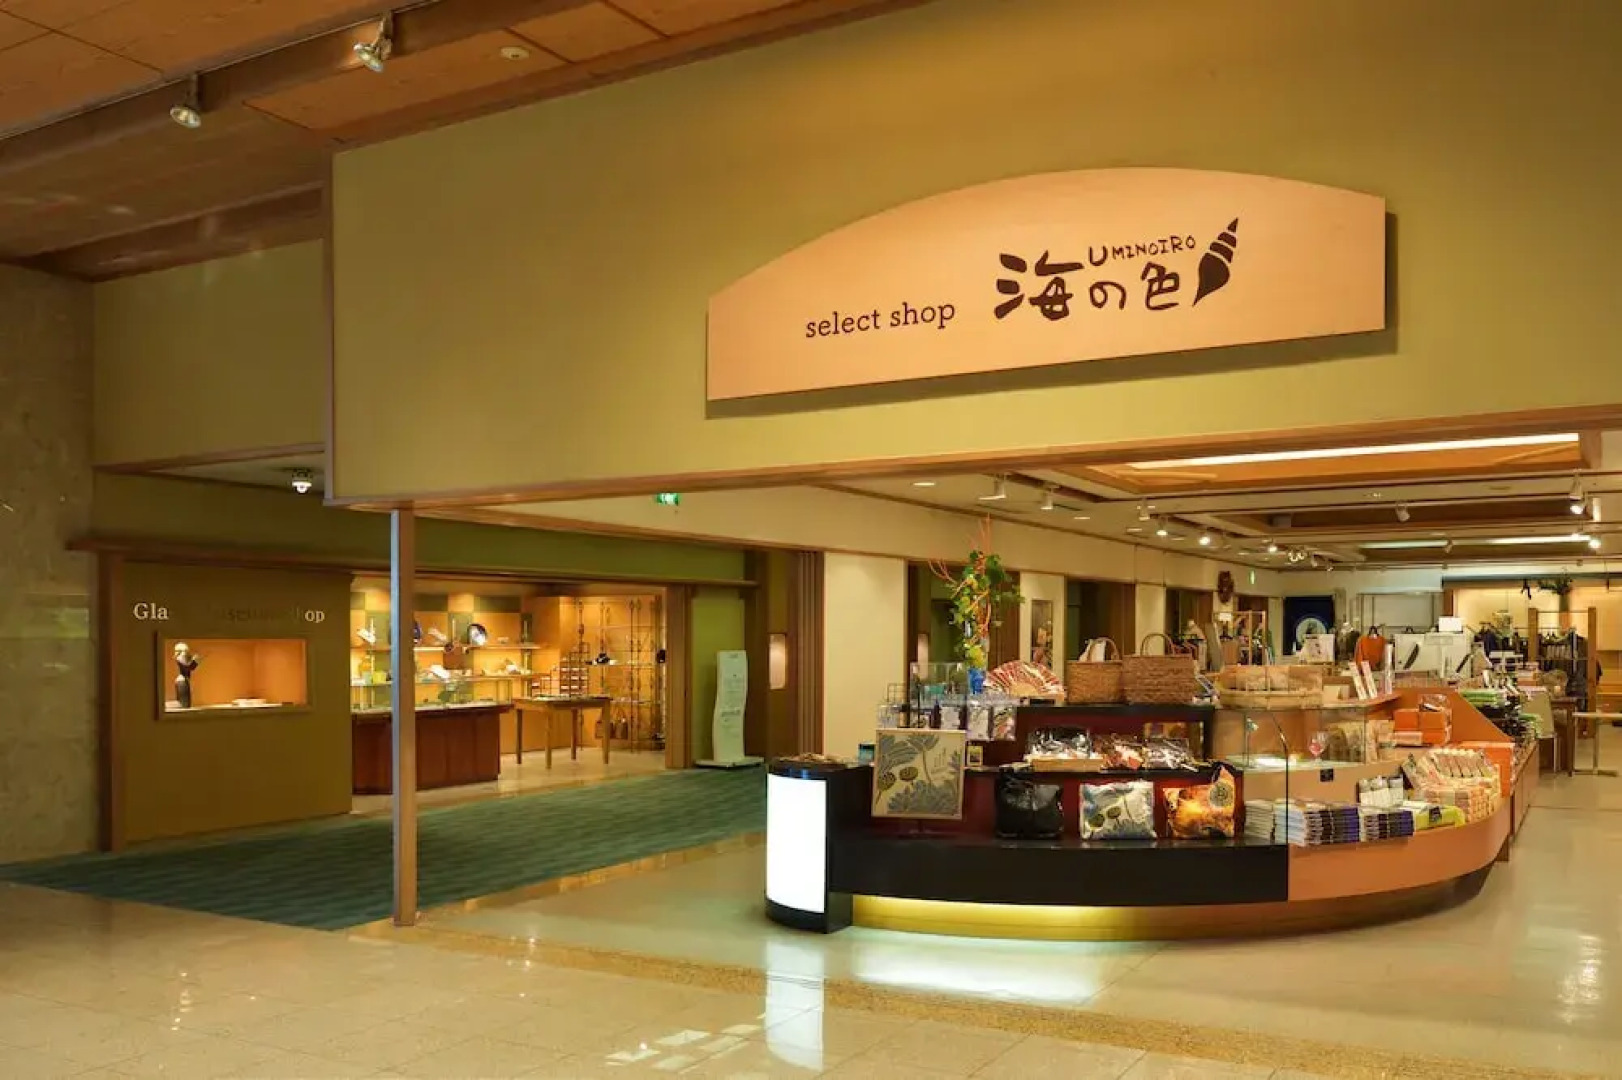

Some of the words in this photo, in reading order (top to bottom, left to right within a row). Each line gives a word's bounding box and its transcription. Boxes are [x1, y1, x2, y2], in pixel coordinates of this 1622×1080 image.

[1089, 235, 1196, 267] UMINOIRO
[993, 250, 1180, 321] 海の色
[805, 309, 880, 338] select
[890, 301, 955, 330] shop
[132, 602, 170, 620] Gla
